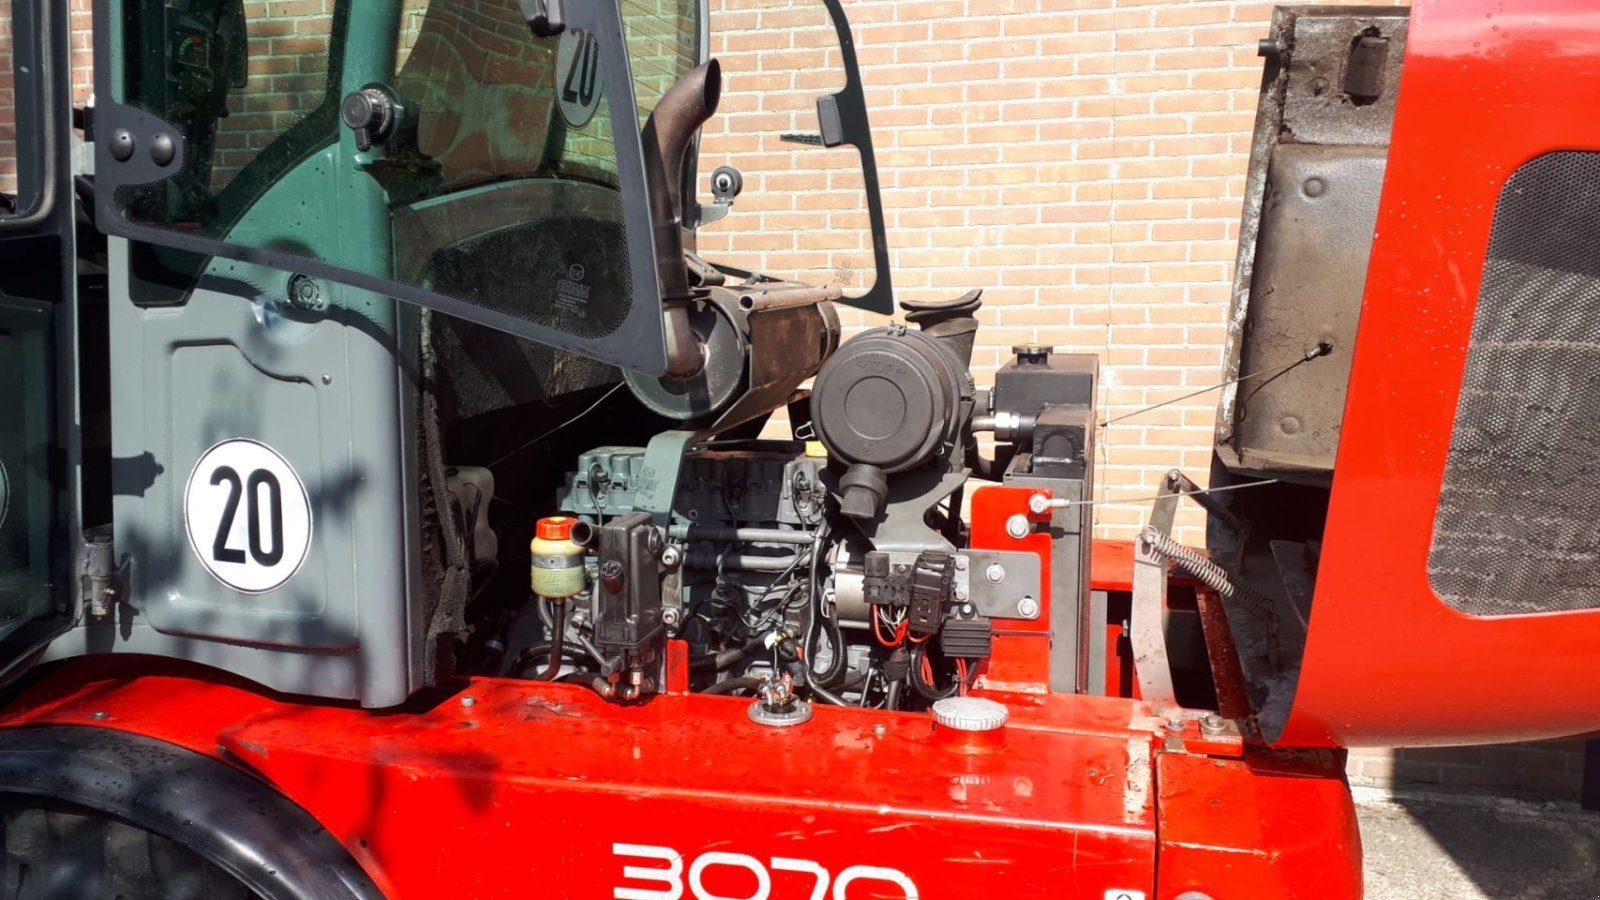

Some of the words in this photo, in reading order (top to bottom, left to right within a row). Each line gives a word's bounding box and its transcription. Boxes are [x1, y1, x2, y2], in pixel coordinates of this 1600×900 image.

[563, 28, 599, 107] 20
[210, 465, 284, 567] 20
[612, 842, 919, 900] 3070
